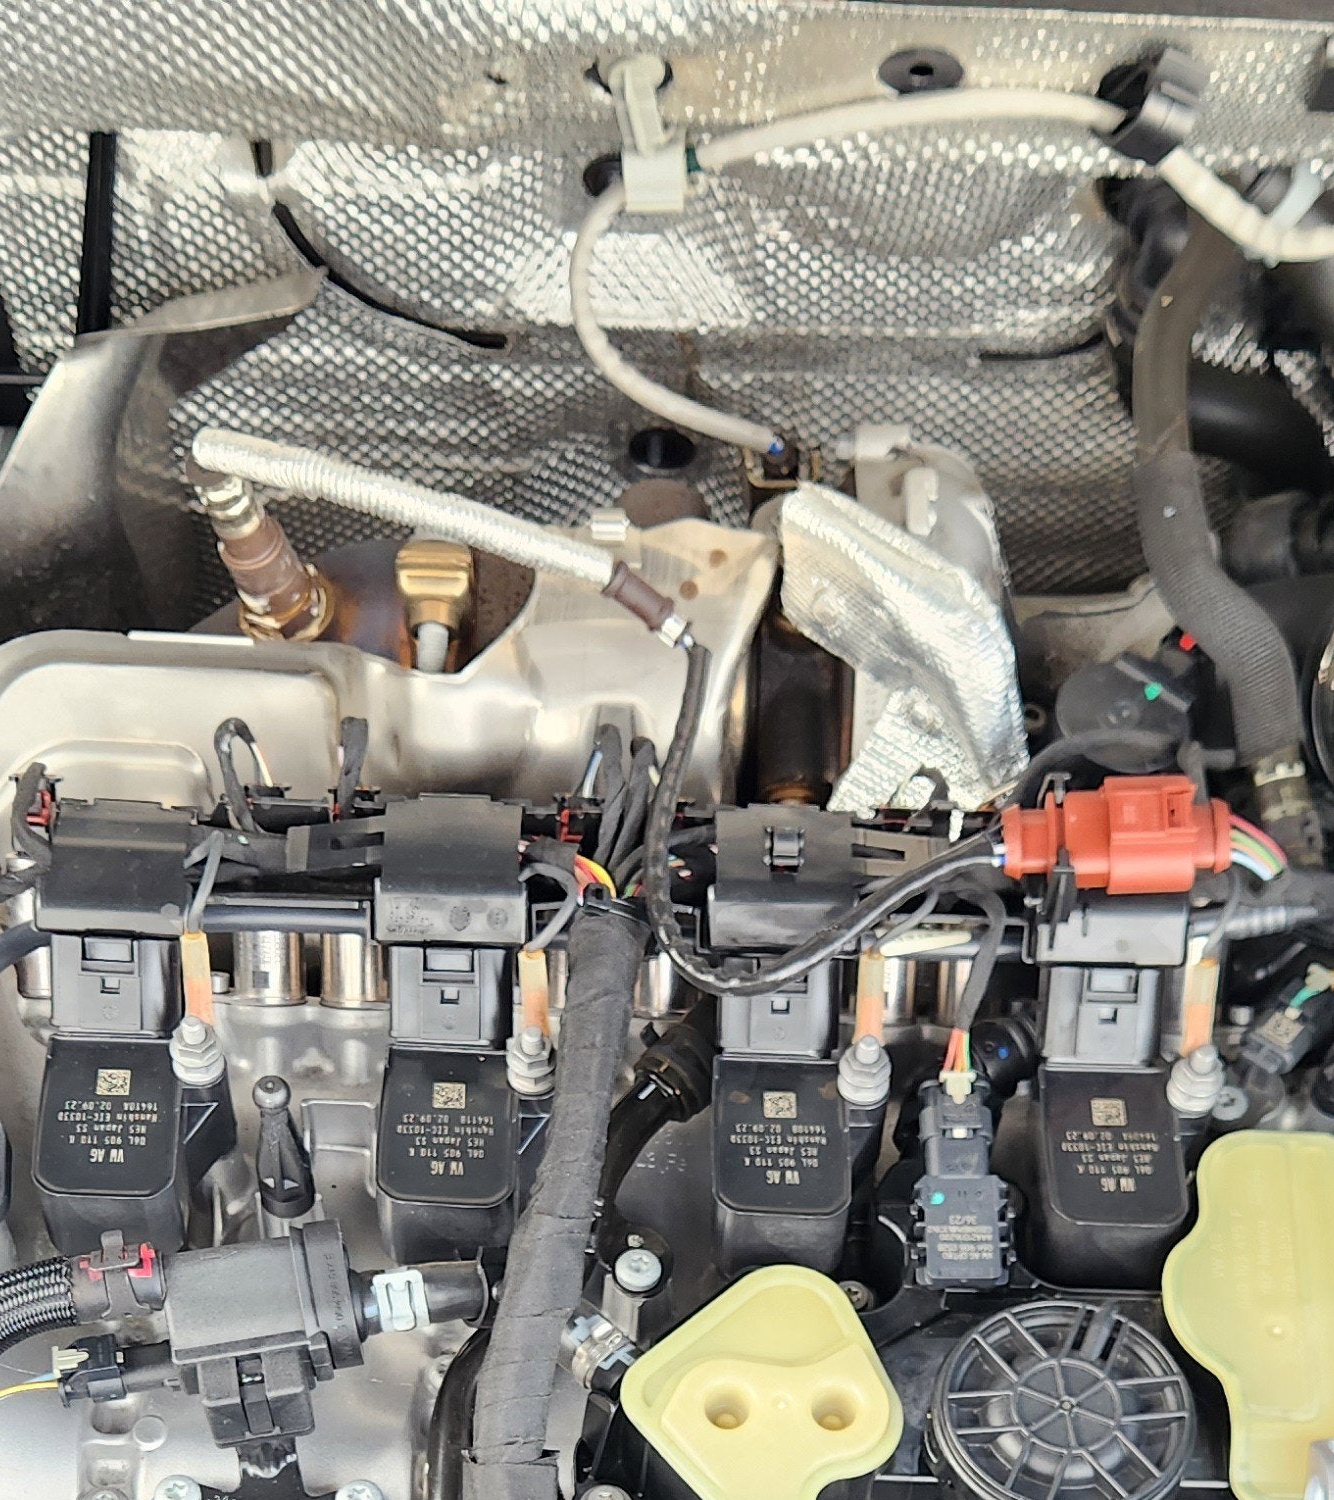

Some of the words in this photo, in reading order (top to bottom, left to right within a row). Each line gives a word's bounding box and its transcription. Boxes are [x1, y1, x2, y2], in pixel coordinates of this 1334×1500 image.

[94, 1124, 123, 1133] Japan
[80, 1135, 97, 1144] 110
[104, 1136, 122, 1145] 905
[128, 1136, 146, 1145] 06L
[432, 1137, 461, 1146] Japan
[90, 1149, 105, 1163] AG
[109, 1149, 124, 1163] VW
[420, 1148, 437, 1157] 110
[443, 1148, 462, 1158] 905
[467, 1149, 485, 1158] 06L
[430, 1161, 445, 1175] AG
[449, 1162, 464, 1175] VW
[766, 1170, 781, 1184] AG
[785, 1170, 800, 1184] VW
[1100, 1177, 1117, 1192] AG
[1119, 1177, 1137, 1192] VW
